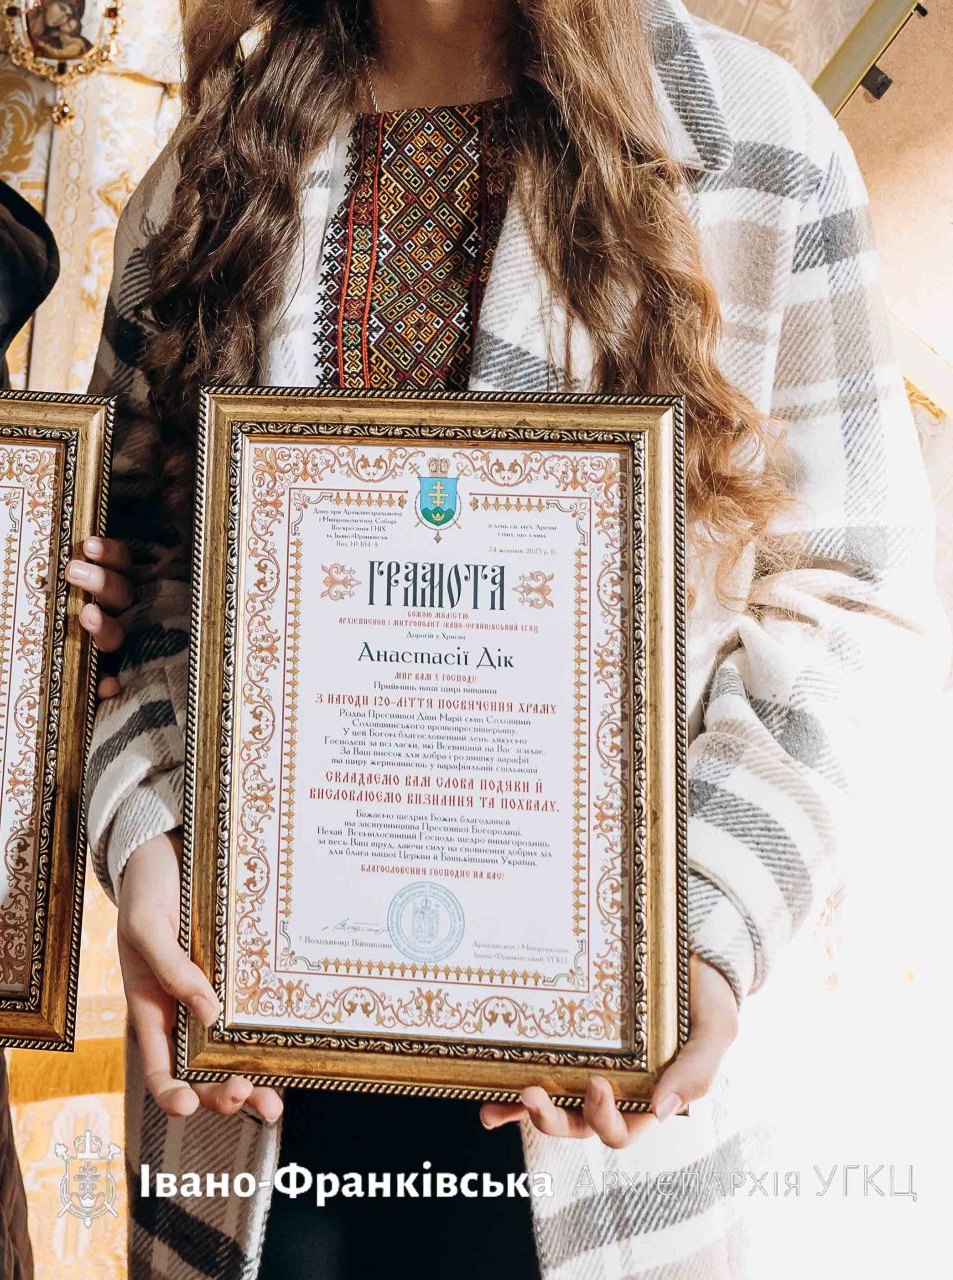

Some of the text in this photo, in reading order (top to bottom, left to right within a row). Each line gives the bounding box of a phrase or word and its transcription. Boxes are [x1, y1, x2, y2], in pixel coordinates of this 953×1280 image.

[368, 560, 506, 611] ГРАМОТА
[357, 641, 515, 671] Анастасії Дік
[315, 693, 557, 715] З НАГОДИ 120-ЛІТТЯ ПОСВЯЧЕННЯ ХРАМУ
[325, 770, 543, 795] СКЛАДАЄМО ВАМ СЛОВА ПОДЯКИ Й
[309, 787, 560, 813] ВИСЛОВЛЮЄМО ВИЗНАННЯ ТА ПОХВАЛУ.
